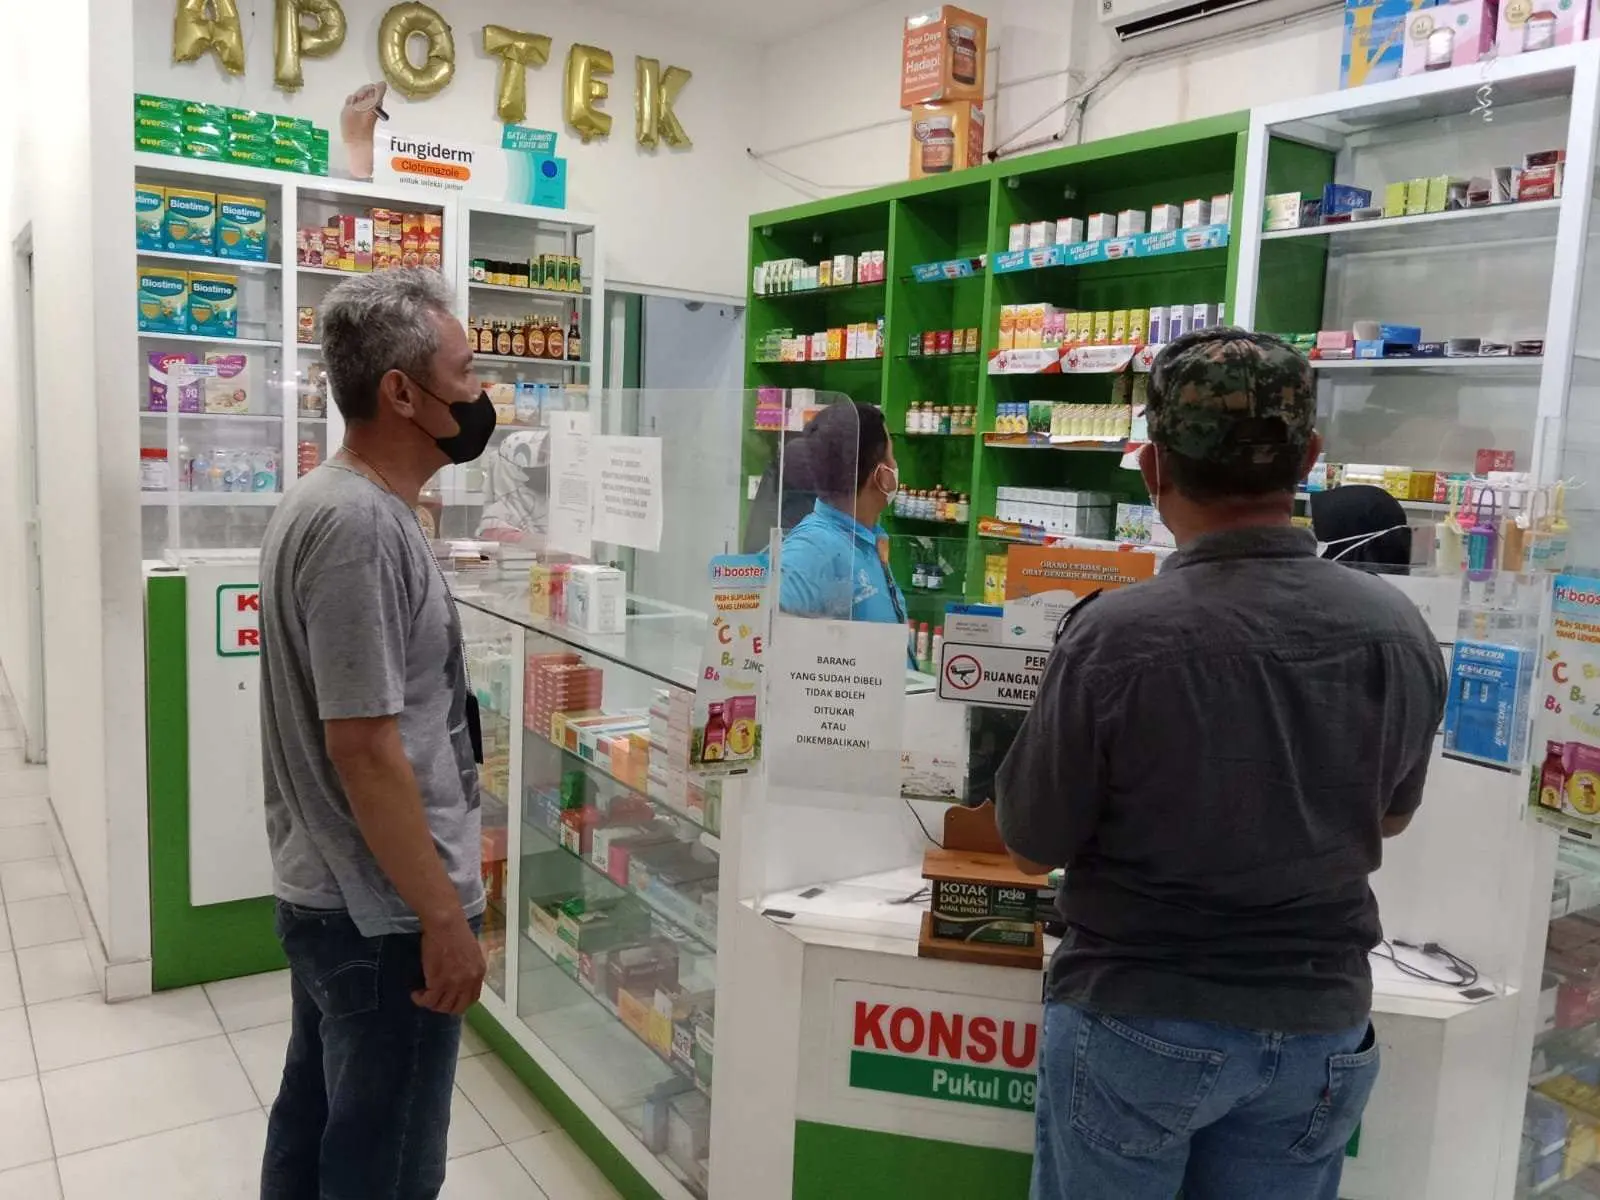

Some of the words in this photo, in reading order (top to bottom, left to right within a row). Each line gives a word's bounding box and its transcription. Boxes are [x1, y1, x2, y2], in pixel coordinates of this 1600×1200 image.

[906, 55, 940, 74] Hadapi
[172, 0, 693, 149] APOTEK
[401, 160, 460, 178] Clotrimazole
[170, 199, 210, 213] Biostime
[222, 205, 261, 217] Biostime
[142, 278, 182, 290] Biostime
[193, 283, 232, 295] Biostime
[724, 566, 764, 577] booster
[237, 594, 259, 612] K
[237, 629, 260, 646] R
[718, 624, 732, 645] C
[752, 636, 763, 655] E
[742, 659, 765, 673] ZINC
[817, 656, 856, 667] BARANG
[1025, 655, 1046, 667] PER
[790, 672, 816, 681] YANG
[818, 673, 851, 684] SUDAH
[983, 670, 1040, 686] RUANGAN
[1552, 661, 1569, 684] C
[805, 687, 833, 698] TIDAK
[835, 689, 865, 700] BOLEH
[997, 687, 1036, 701] KAMER
[814, 705, 855, 717] DITUKAR
[1544, 695, 1562, 714] B6
[820, 721, 847, 732] ATAU
[796, 734, 870, 749] DIKEMBALIKAN!
[940, 881, 988, 897] KOTAK
[939, 893, 988, 907] DONASI
[854, 1001, 1037, 1069] KONSU
[932, 1068, 1000, 1101] Pukul
[1008, 1078, 1037, 1106] 09
